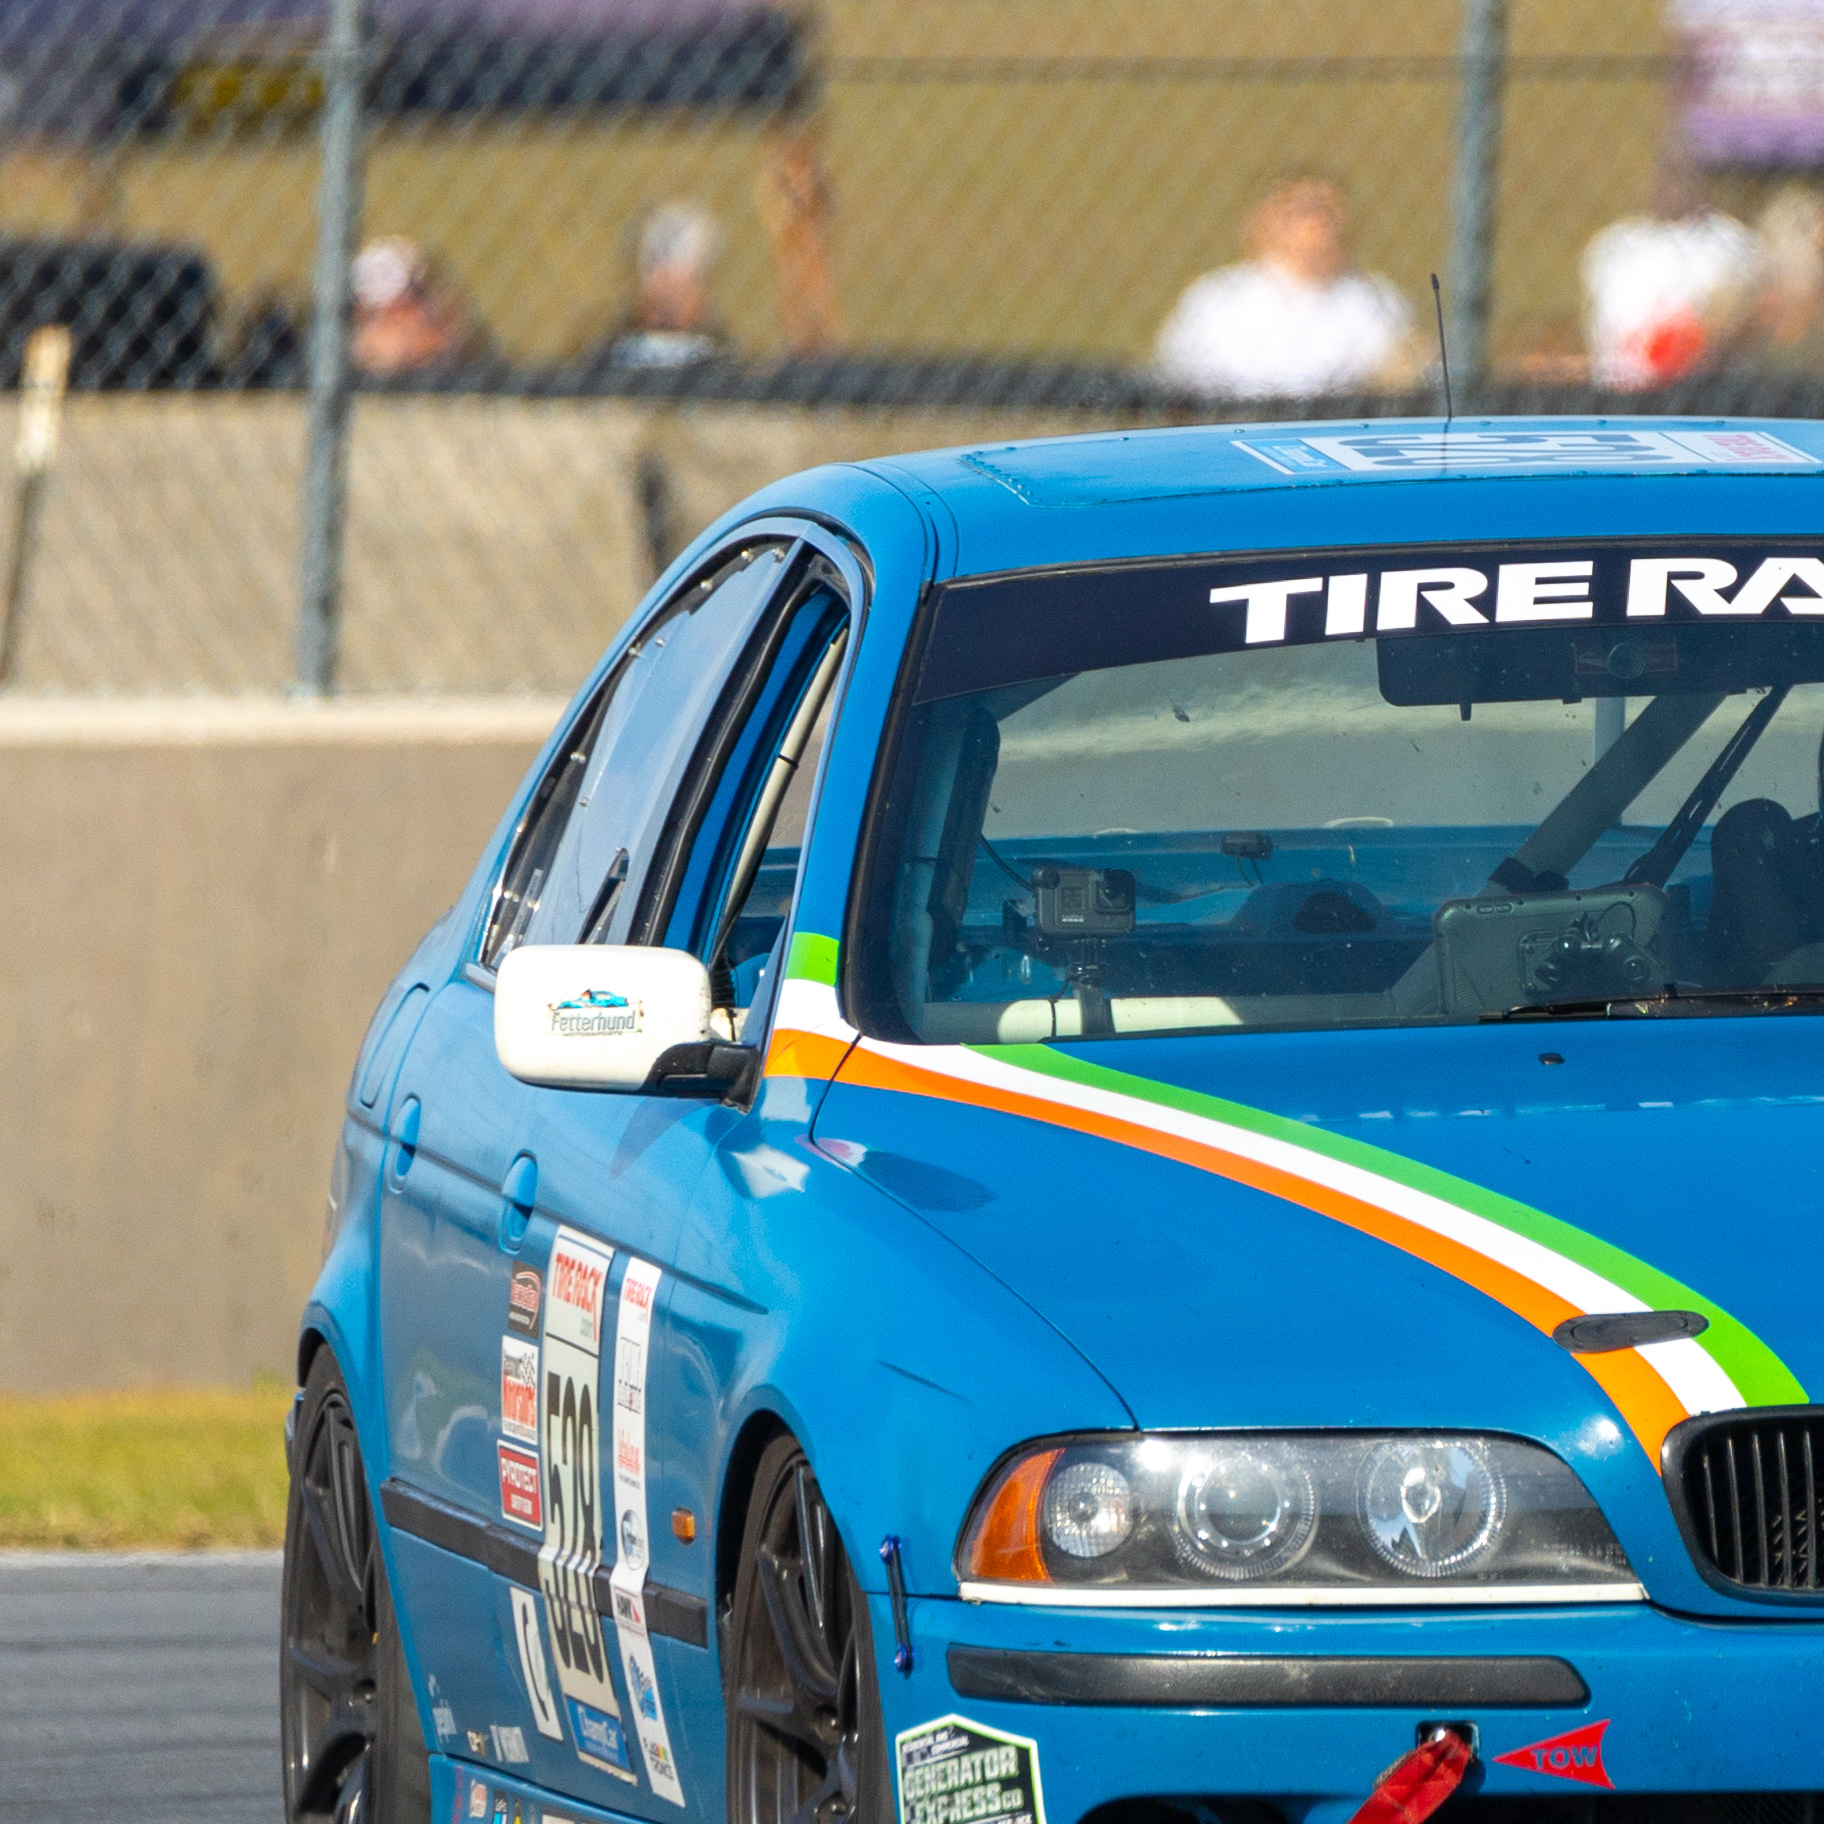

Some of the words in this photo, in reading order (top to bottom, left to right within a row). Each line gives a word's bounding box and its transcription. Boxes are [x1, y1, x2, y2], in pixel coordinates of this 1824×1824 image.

[1338, 434, 1675, 467] 528
[1210, 560, 1594, 644] TIRE
[551, 1009, 636, 1031] Fetterhund
[544, 1371, 604, 1684] 528
[904, 1744, 1020, 1802] GENERATOR
[1531, 1745, 1598, 1769] TOW
